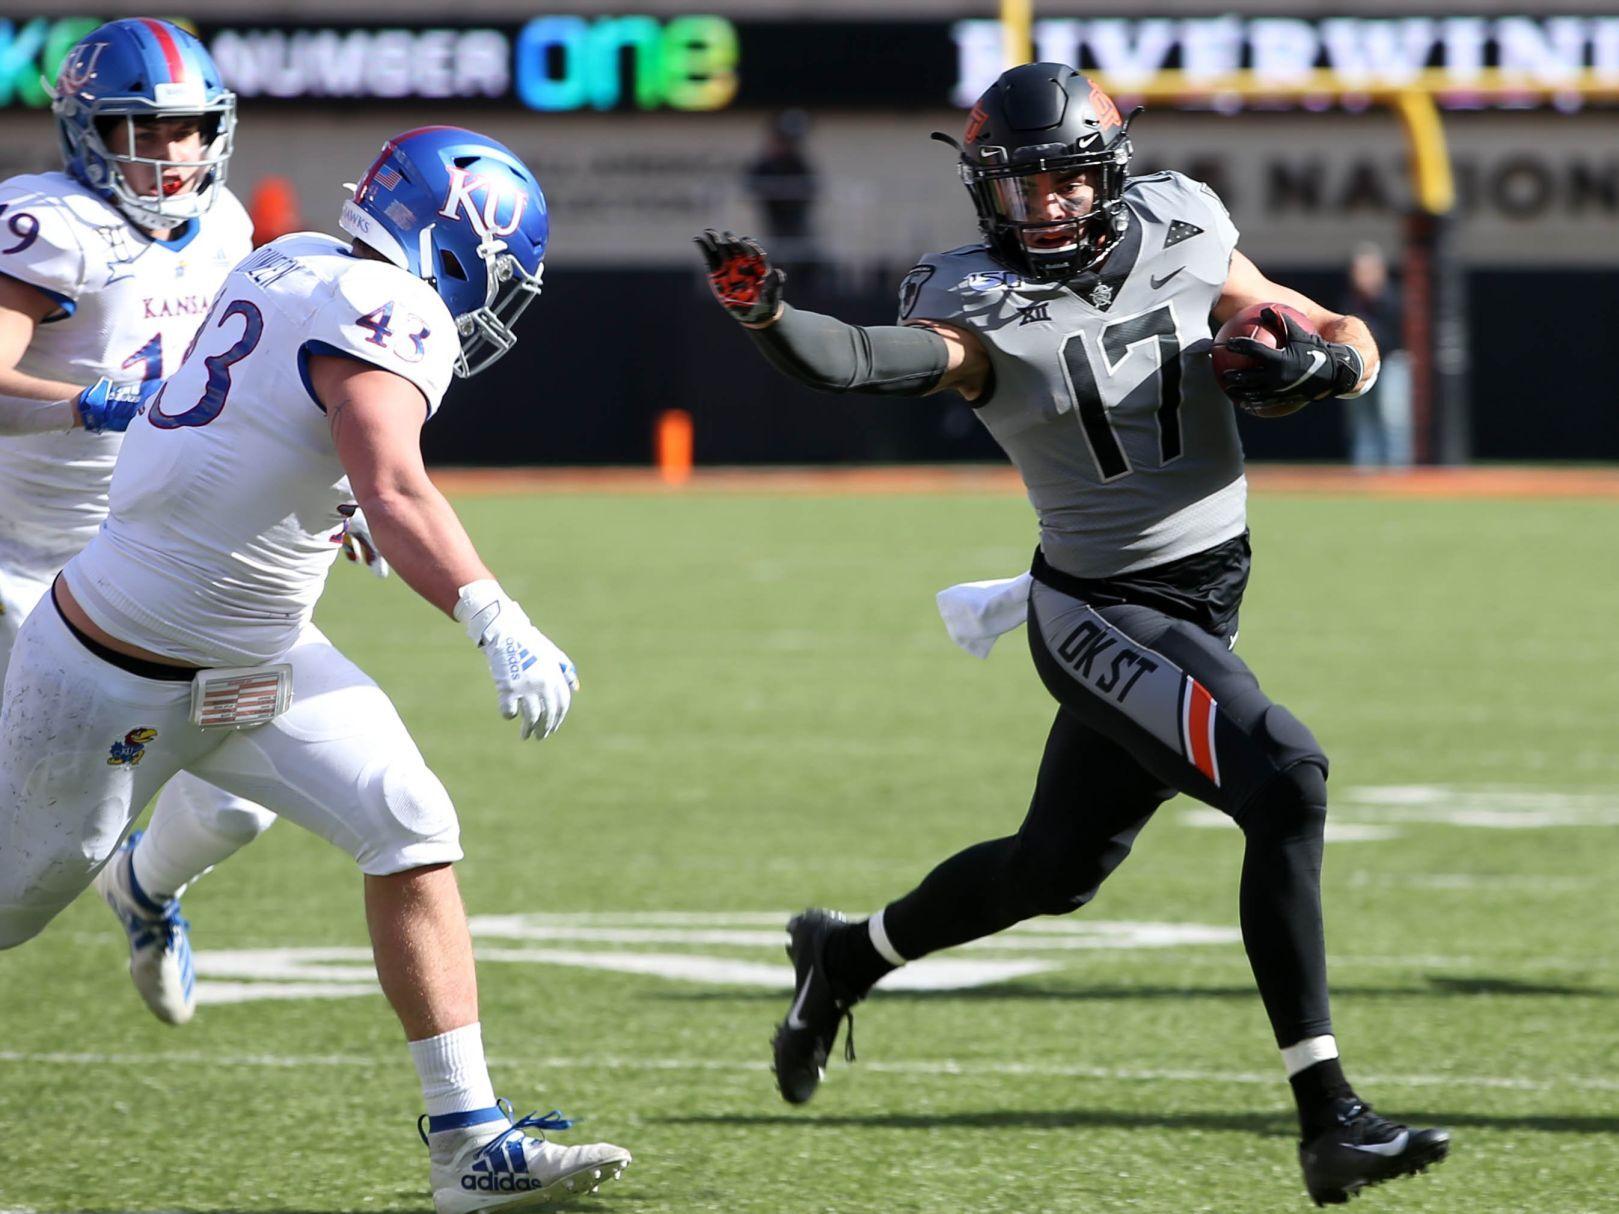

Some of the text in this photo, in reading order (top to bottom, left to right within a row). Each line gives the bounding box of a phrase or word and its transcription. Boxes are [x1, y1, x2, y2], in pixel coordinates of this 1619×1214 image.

[211, 28, 509, 98] NUMBER
[516, 14, 740, 111] one
[0, 204, 40, 255] 9
[438, 166, 529, 238] KU
[142, 295, 209, 319] KANSA
[355, 300, 432, 363] 43
[147, 299, 264, 430] 3
[1057, 299, 1184, 485] 17
[505, 636, 521, 681] adidas
[1057, 619, 1159, 704] OK ST
[461, 1171, 542, 1192] adidas
